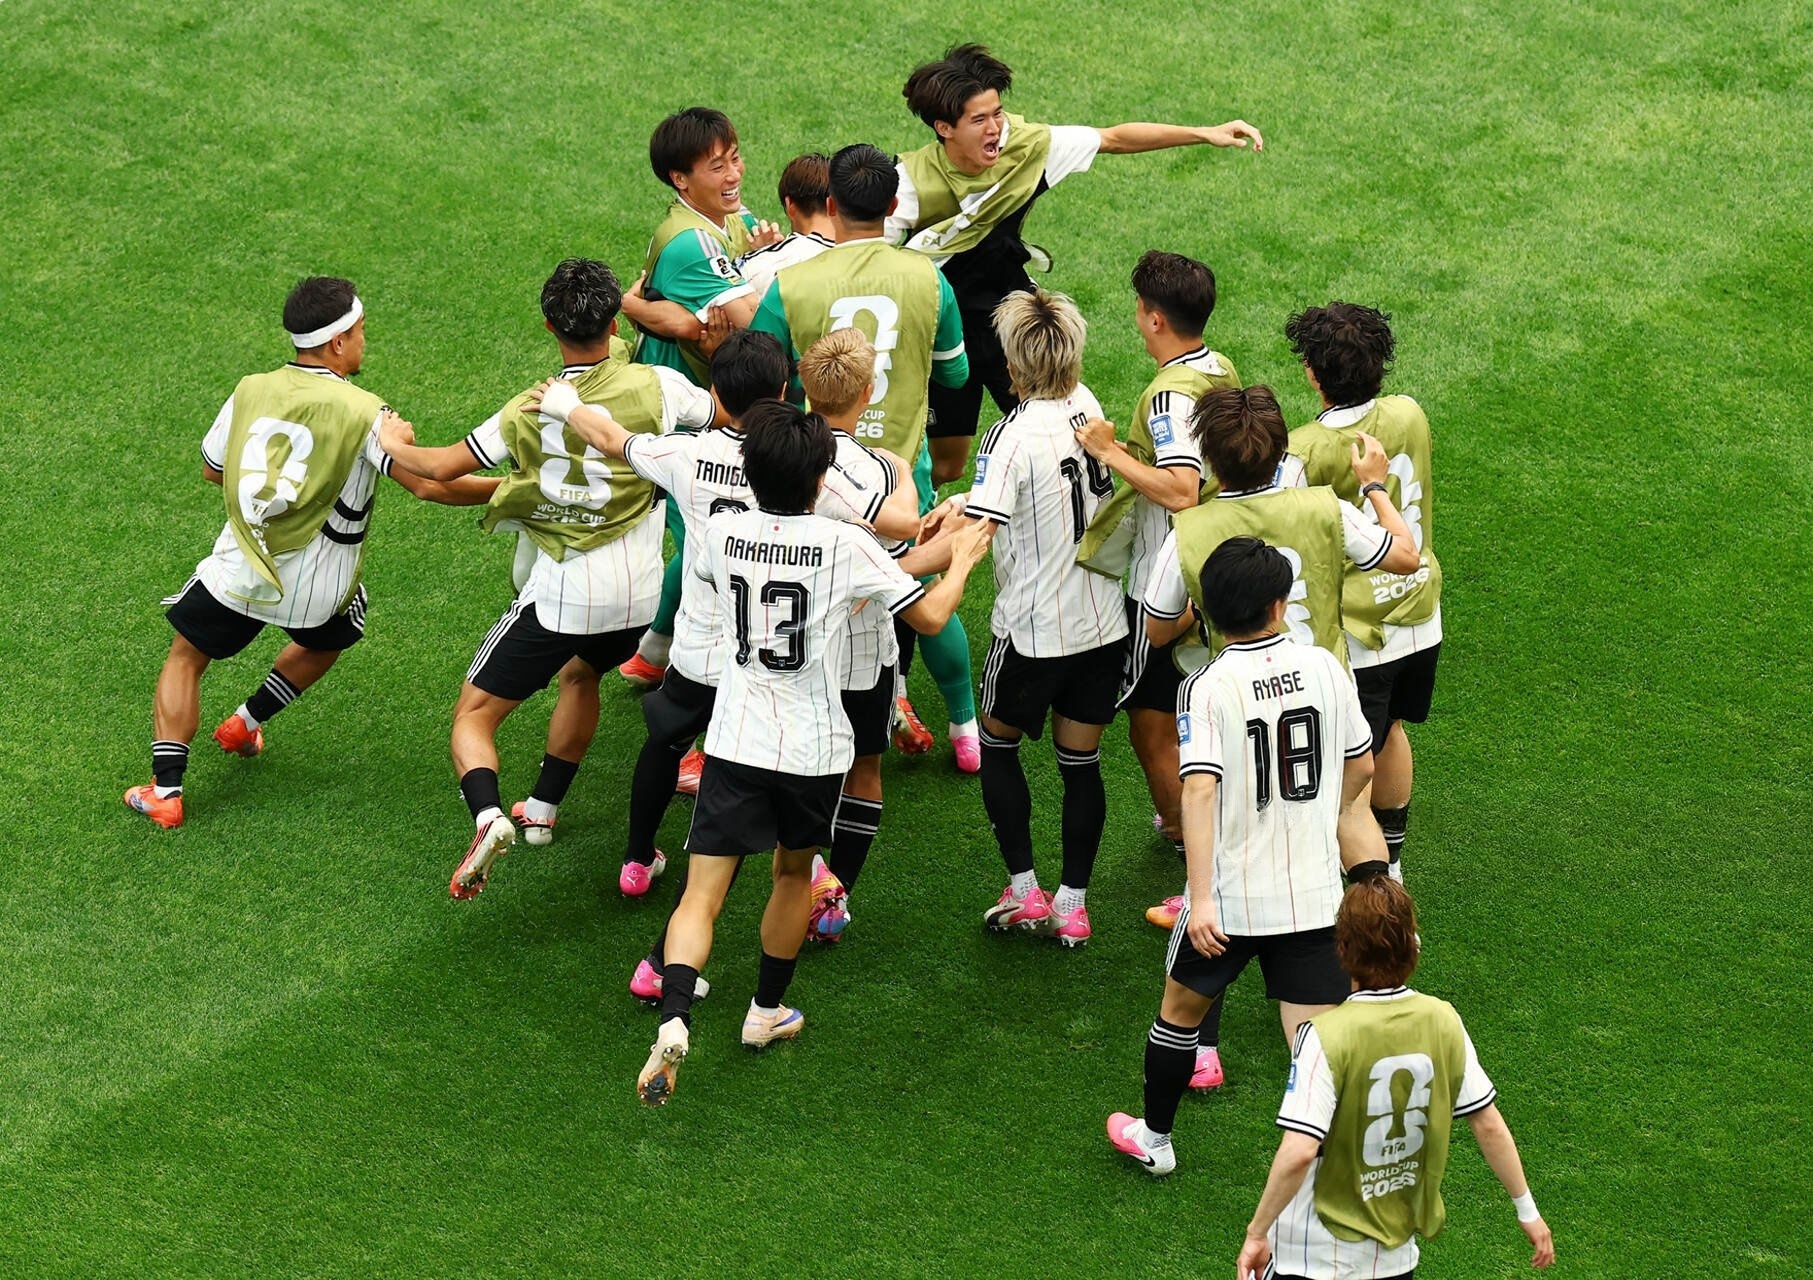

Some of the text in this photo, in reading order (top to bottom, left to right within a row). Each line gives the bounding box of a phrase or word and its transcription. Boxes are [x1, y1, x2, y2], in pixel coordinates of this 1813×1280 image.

[864, 409, 886, 420] CUP
[855, 421, 884, 439] 26
[696, 459, 748, 487] TANIGU
[559, 488, 593, 502] FIFA
[537, 503, 580, 517] WORLD
[581, 512, 607, 524] CUP
[724, 535, 823, 567] NAKAMURA
[1369, 573, 1405, 587] WOR
[1373, 568, 1431, 605] 2026
[730, 574, 812, 673] 13
[1253, 671, 1305, 701] AYASE
[1246, 706, 1323, 812] 18
[1381, 1142, 1406, 1157] FIFA
[1360, 1167, 1400, 1183] WORLD
[1361, 1172, 1416, 1202] 2026
